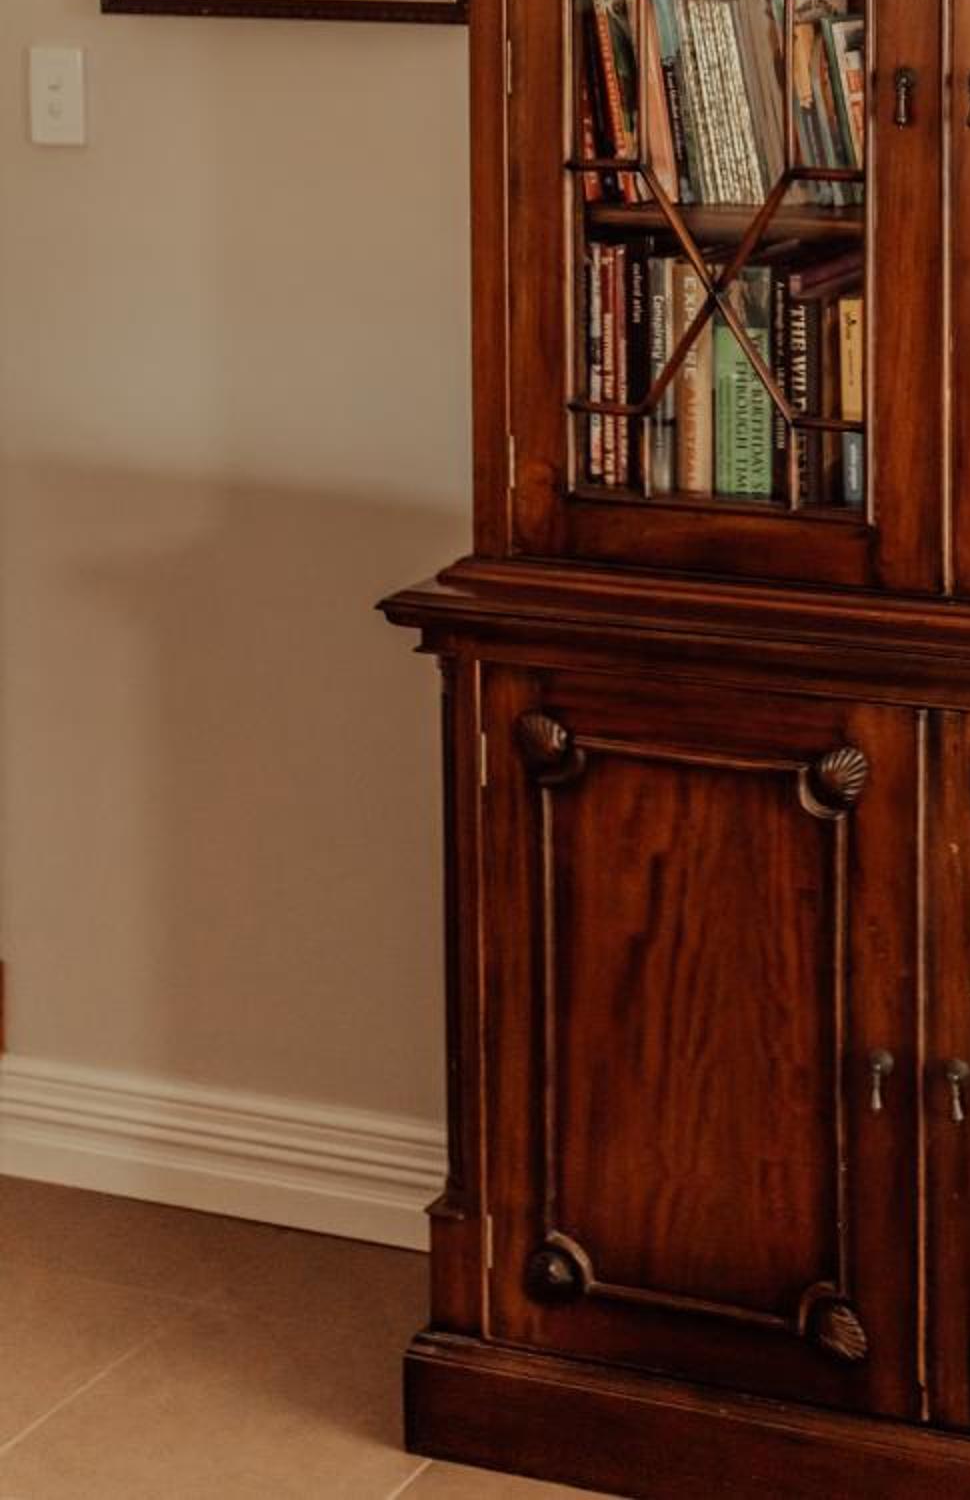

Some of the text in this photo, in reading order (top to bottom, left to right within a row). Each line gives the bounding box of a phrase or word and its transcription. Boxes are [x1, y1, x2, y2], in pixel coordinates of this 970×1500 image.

[652, 294, 665, 359] Conspiracy
[790, 304, 807, 352] THE
[735, 360, 749, 495] THROUGH TIM
